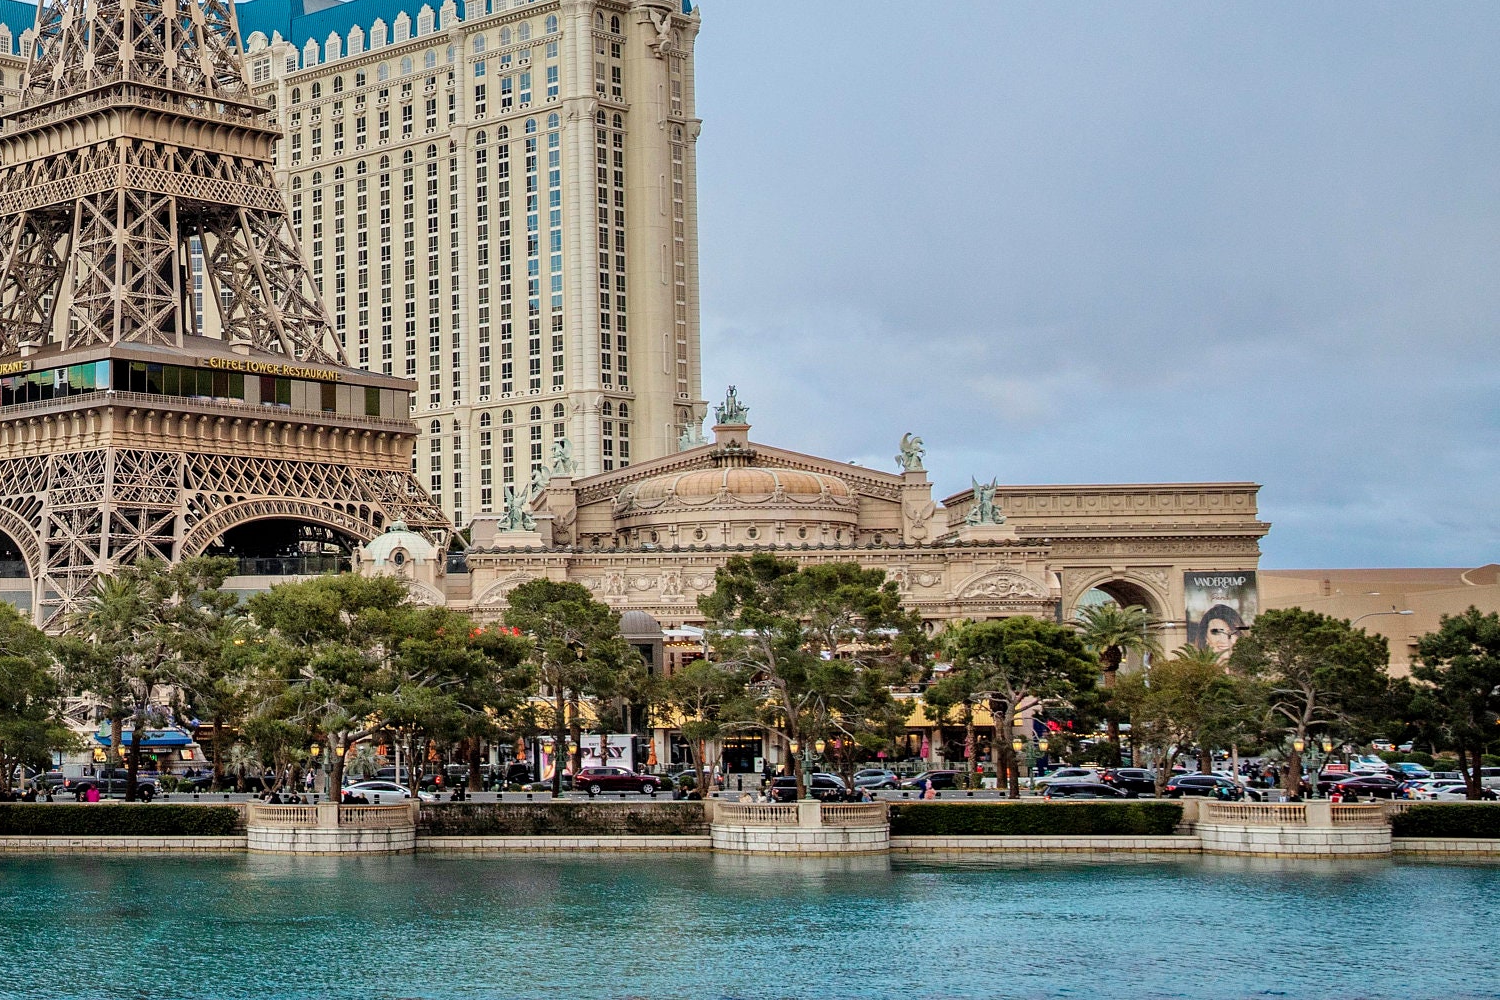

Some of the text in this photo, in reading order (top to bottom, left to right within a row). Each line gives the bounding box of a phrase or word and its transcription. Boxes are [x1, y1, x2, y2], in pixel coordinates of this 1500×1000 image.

[210, 356, 340, 381] EIFFEL TOWER RESTAURANT
[1193, 576, 1247, 589] VANDERPUMP
